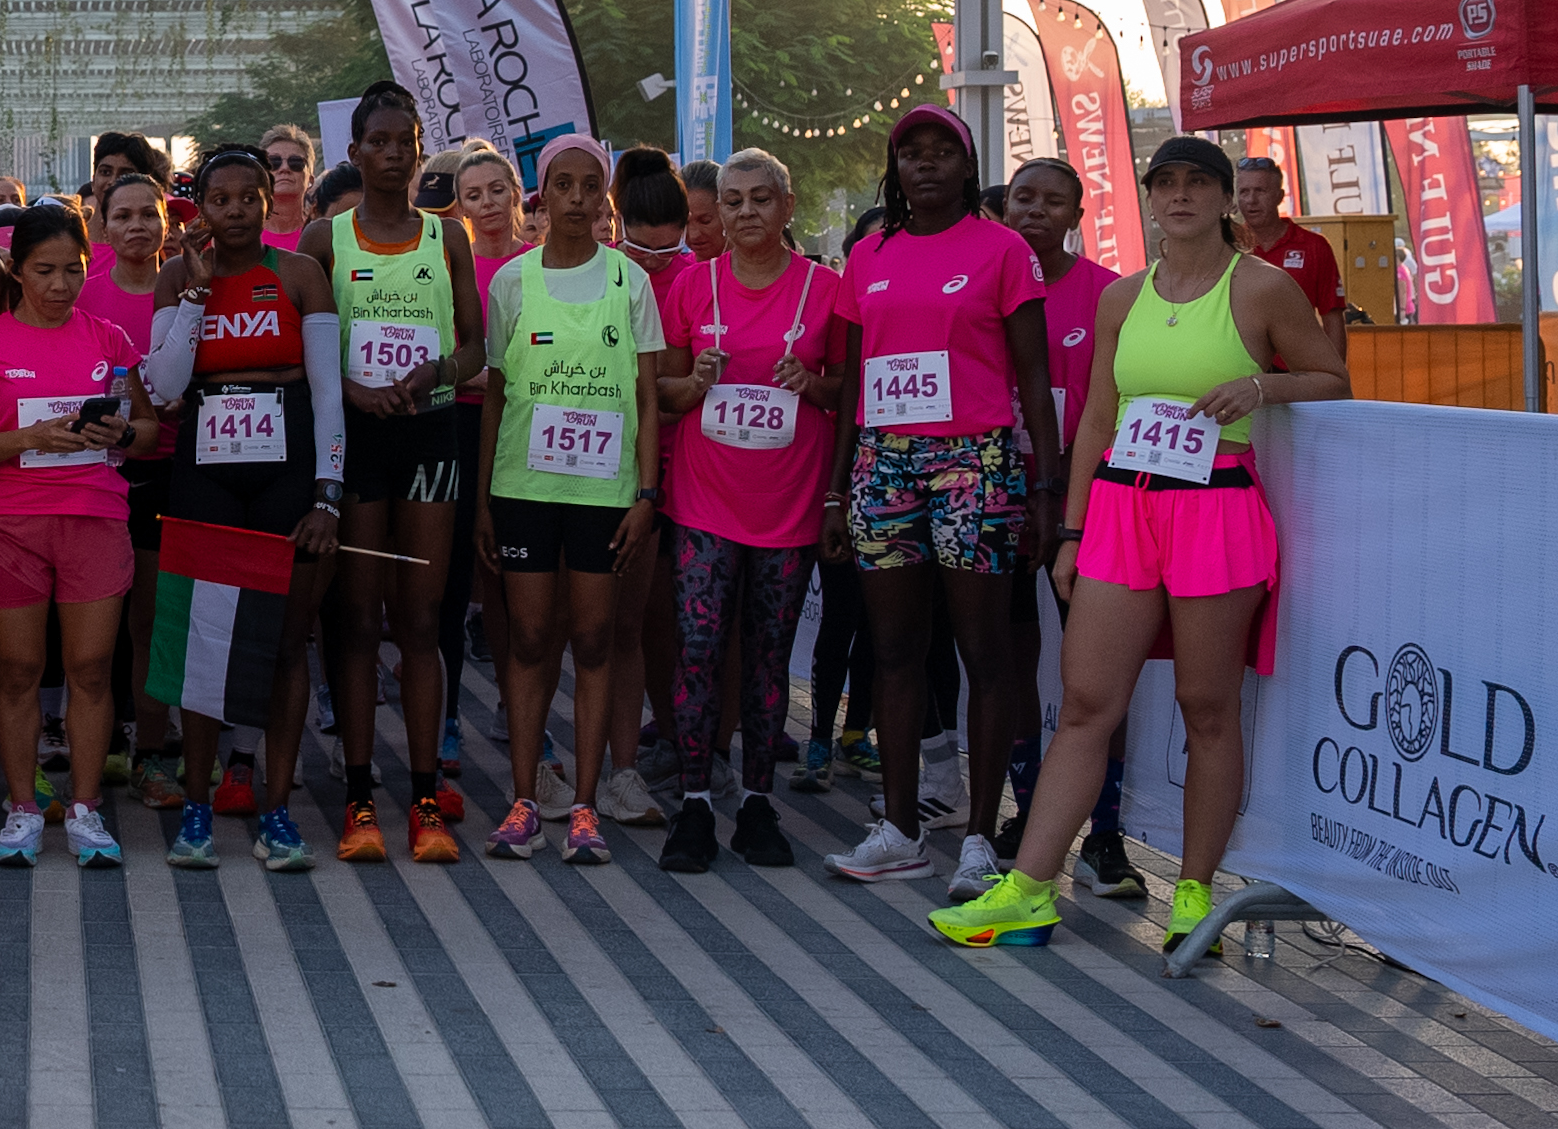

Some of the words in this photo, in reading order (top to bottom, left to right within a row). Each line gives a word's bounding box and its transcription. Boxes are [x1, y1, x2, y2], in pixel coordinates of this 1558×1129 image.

[1216, 21, 1454, 81] www.supersportsuae.com
[200, 310, 280, 341] ENYA
[352, 306, 370, 319] Bin
[373, 306, 434, 320] Kharbash
[359, 340, 429, 370] 1503
[529, 381, 547, 396] Bin
[550, 380, 622, 399] Kharbash
[872, 373, 939, 402] 1445
[205, 413, 274, 439] 1414
[714, 401, 784, 430] 1128
[541, 425, 613, 455] 1517
[1128, 418, 1205, 454] 1415
[502, 545, 528, 558] EOS
[1334, 642, 1535, 775] GOLD
[1310, 812, 1348, 851] BEAUTY
[1345, 828, 1378, 863] FROM
[1367, 840, 1396, 872] THE
[1384, 845, 1428, 887] INSIDE
[1425, 862, 1460, 895] OUT
